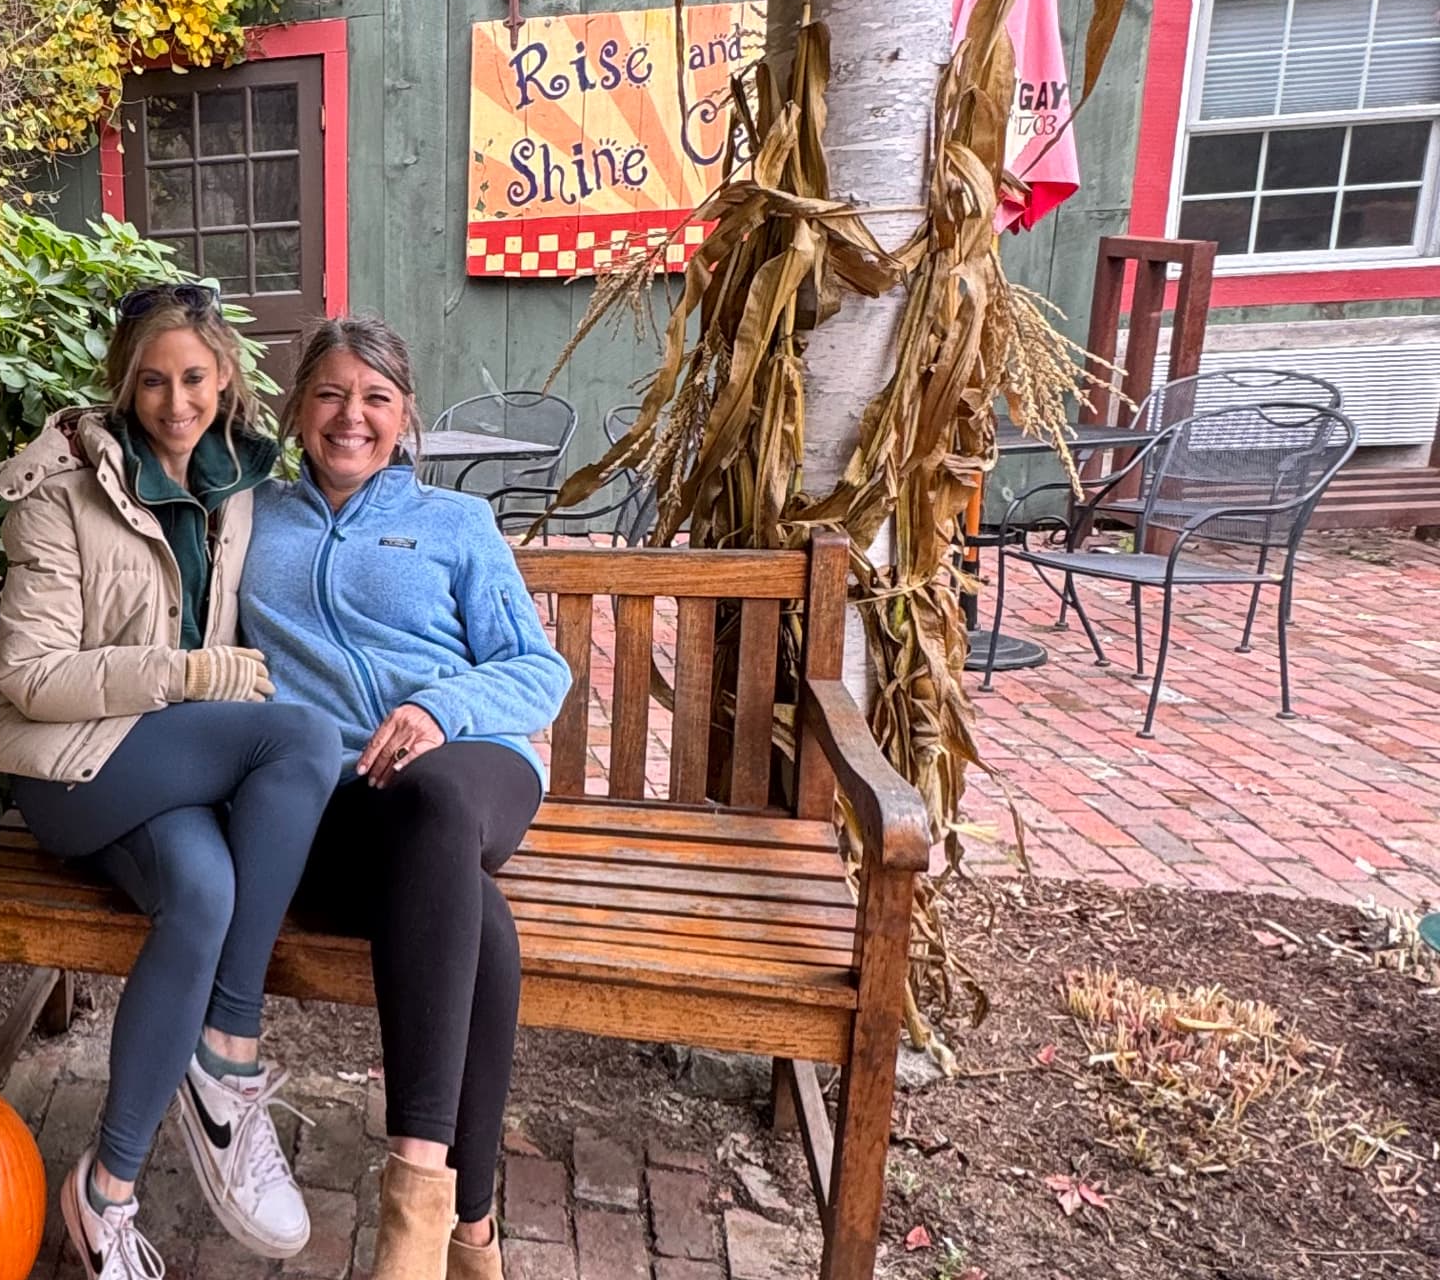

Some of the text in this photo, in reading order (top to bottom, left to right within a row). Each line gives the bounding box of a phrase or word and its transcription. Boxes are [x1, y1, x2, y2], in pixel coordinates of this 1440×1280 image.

[510, 23, 742, 110] Rise and
[1019, 81, 1067, 111] GAY
[1018, 114, 1057, 136] 1703
[507, 138, 647, 206] Shine
